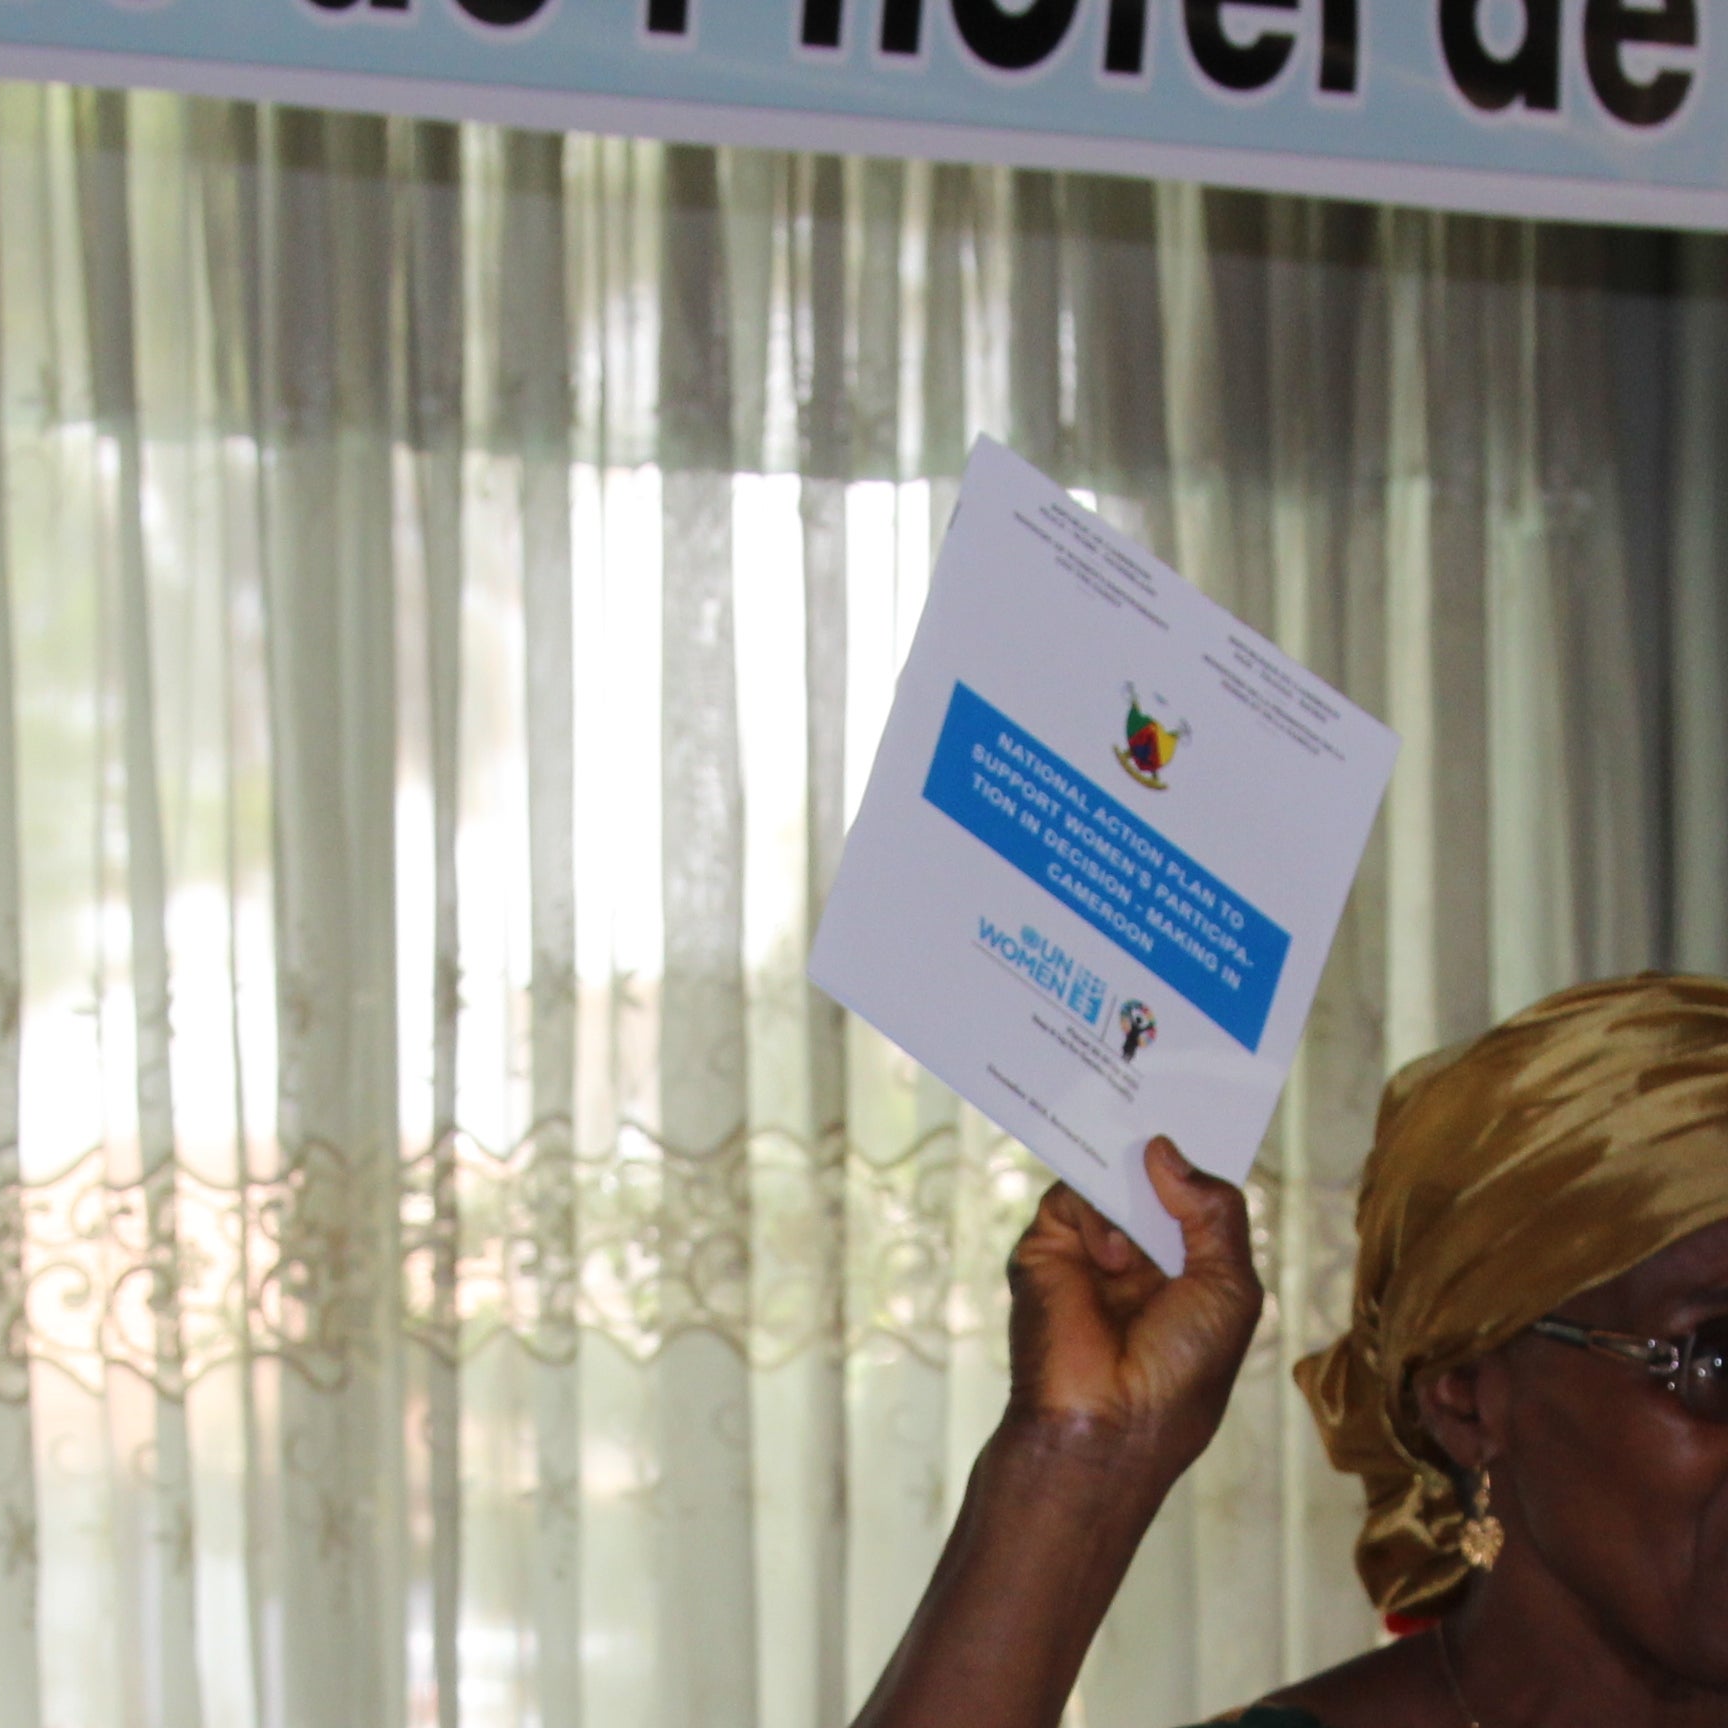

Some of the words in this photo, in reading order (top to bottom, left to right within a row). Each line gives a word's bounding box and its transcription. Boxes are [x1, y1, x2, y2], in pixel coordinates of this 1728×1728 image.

[972, 743, 1061, 818] SUPPORT
[1064, 812, 1152, 890] WOMEN'S
[998, 732, 1090, 814] NATIONAL
[1092, 807, 1164, 867] ACTION
[1166, 861, 1216, 908] PLAN
[1221, 900, 1245, 930] TO
[972, 772, 1016, 817] TION
[1019, 810, 1041, 835] IN
[1043, 828, 1132, 905] DECISION
[1146, 907, 1218, 972] MAKING
[1222, 965, 1242, 991] IN
[1046, 862, 1153, 954] CAMEROON
[979, 916, 1067, 1000] WOMEN
[1040, 939, 1074, 977] UN
